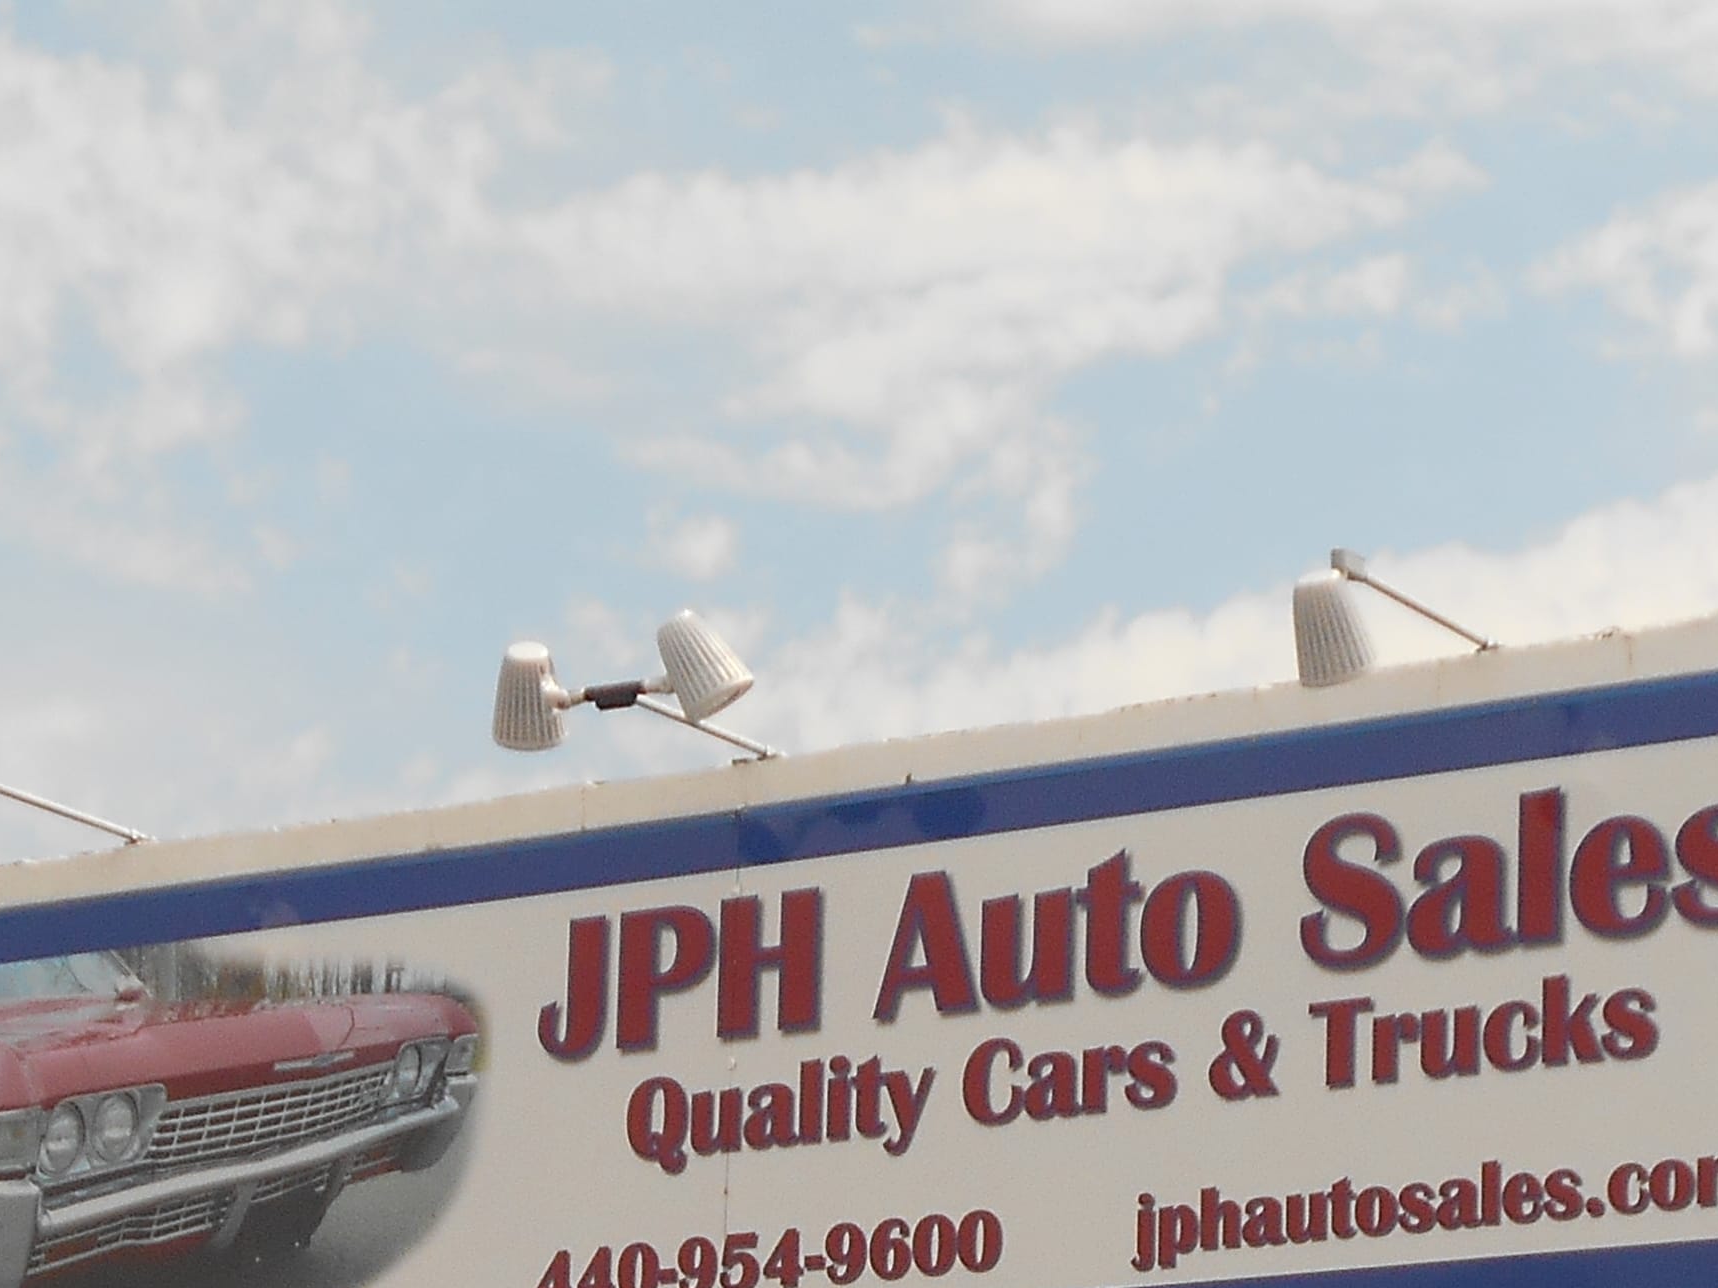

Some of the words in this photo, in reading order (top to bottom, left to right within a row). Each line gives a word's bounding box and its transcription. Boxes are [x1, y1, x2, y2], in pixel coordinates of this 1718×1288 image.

[536, 886, 823, 1062] JPH
[873, 849, 1242, 1015] Auto
[626, 1055, 935, 1175] Quality
[962, 1038, 1178, 1126] Cars
[1208, 1009, 1279, 1100] &
[1308, 974, 1659, 1089] Trucks
